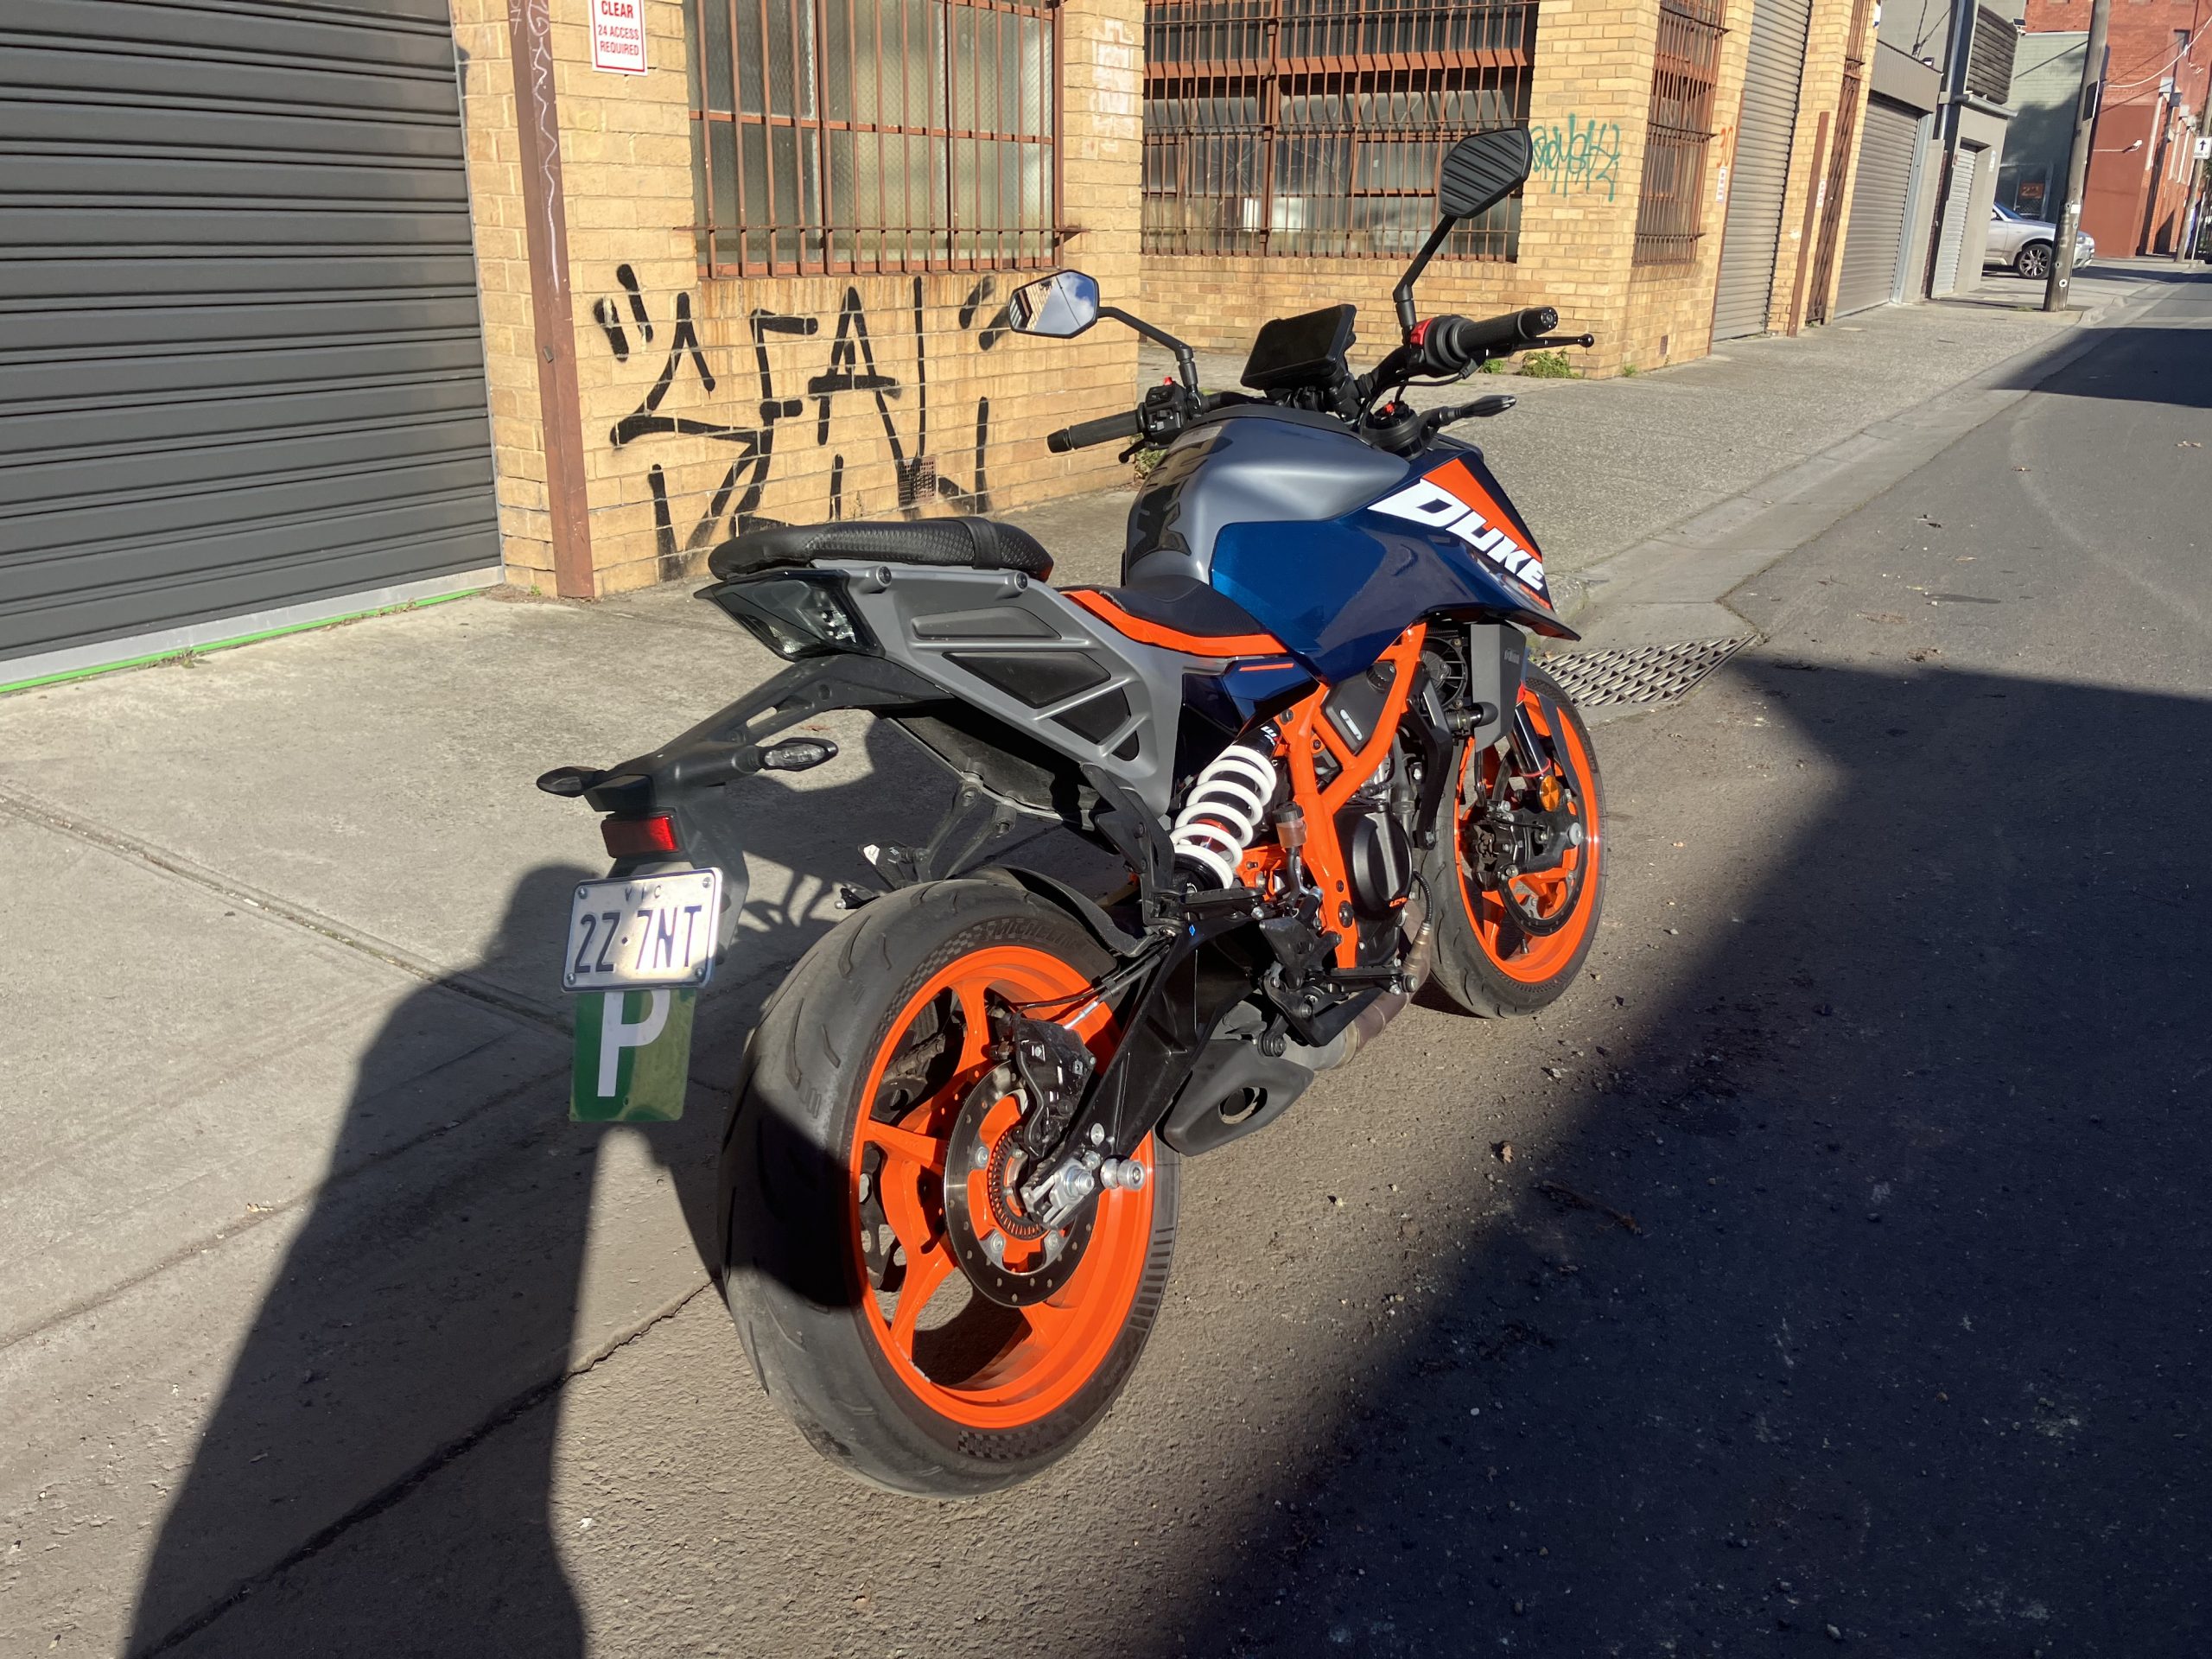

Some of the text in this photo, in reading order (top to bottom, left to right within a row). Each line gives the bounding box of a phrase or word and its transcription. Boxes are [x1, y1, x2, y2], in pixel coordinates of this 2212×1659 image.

[601, 0, 633, 18] CLEAR
[598, 24, 639, 41] 24 ACCESS
[600, 41, 639, 56] REQUIRED
[1366, 478, 1545, 591] DUKE
[625, 884, 663, 902] VIC
[597, 989, 671, 1097] P
